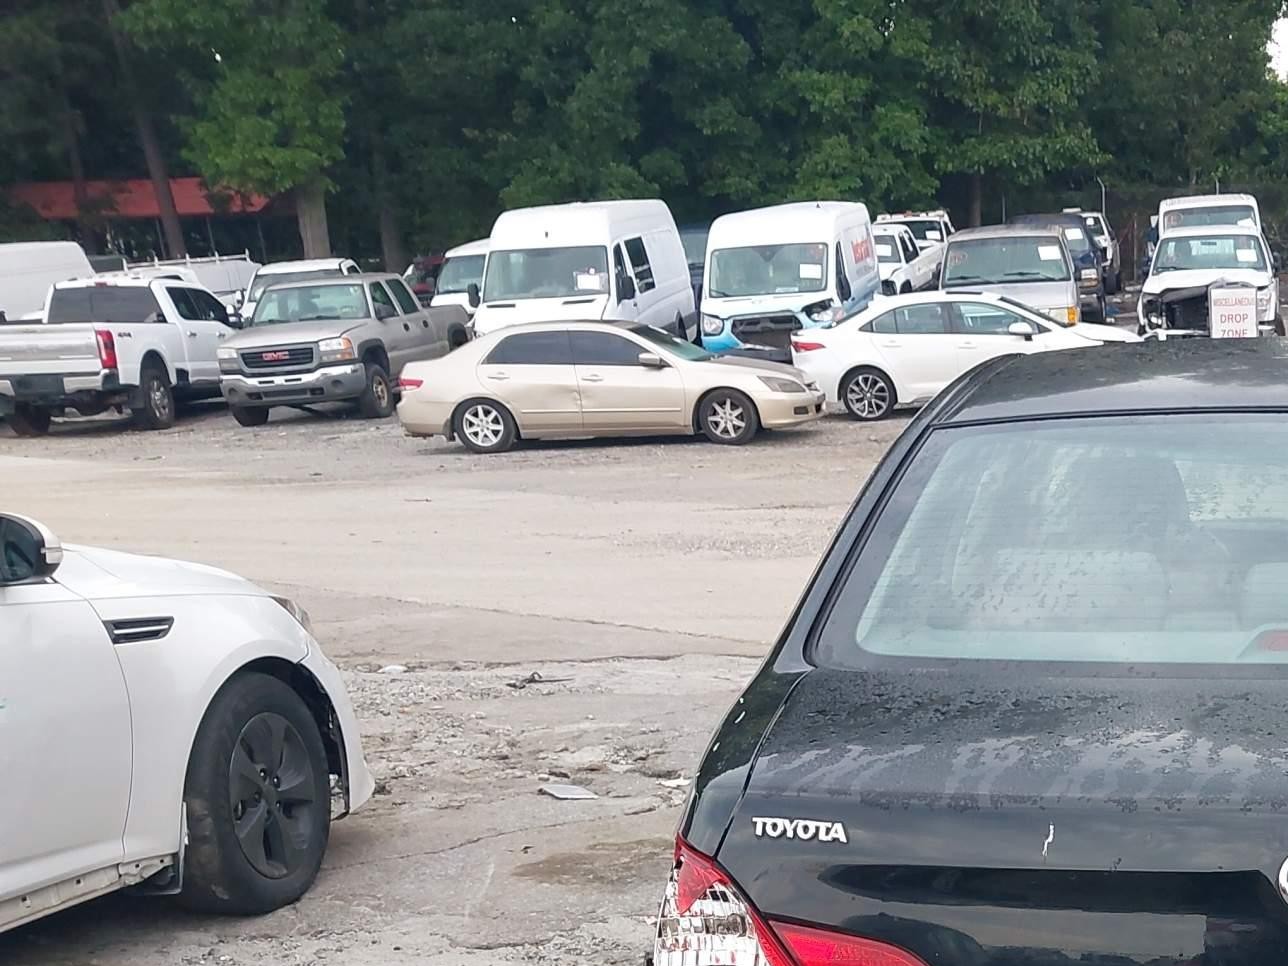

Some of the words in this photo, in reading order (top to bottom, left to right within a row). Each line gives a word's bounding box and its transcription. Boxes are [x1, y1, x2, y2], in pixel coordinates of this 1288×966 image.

[1220, 313, 1249, 324] DROP
[262, 351, 289, 361] GMC
[752, 817, 848, 843] TOYOTA
